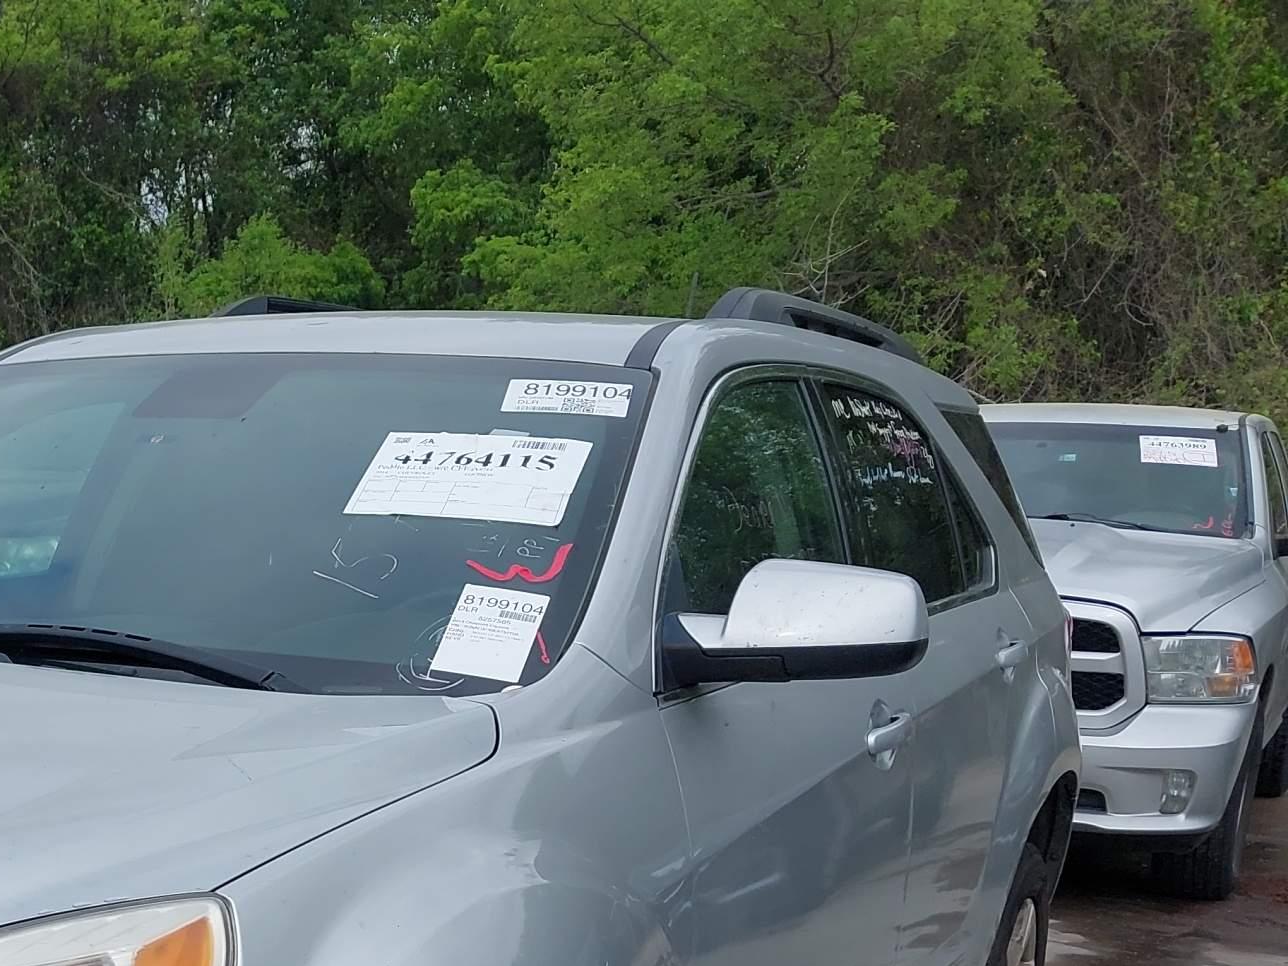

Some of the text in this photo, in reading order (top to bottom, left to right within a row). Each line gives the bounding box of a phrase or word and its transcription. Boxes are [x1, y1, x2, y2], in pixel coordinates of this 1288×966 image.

[523, 382, 633, 400] 8199104
[394, 449, 559, 472] 44764115
[457, 604, 479, 614] DLR
[463, 594, 545, 616] 8199104
